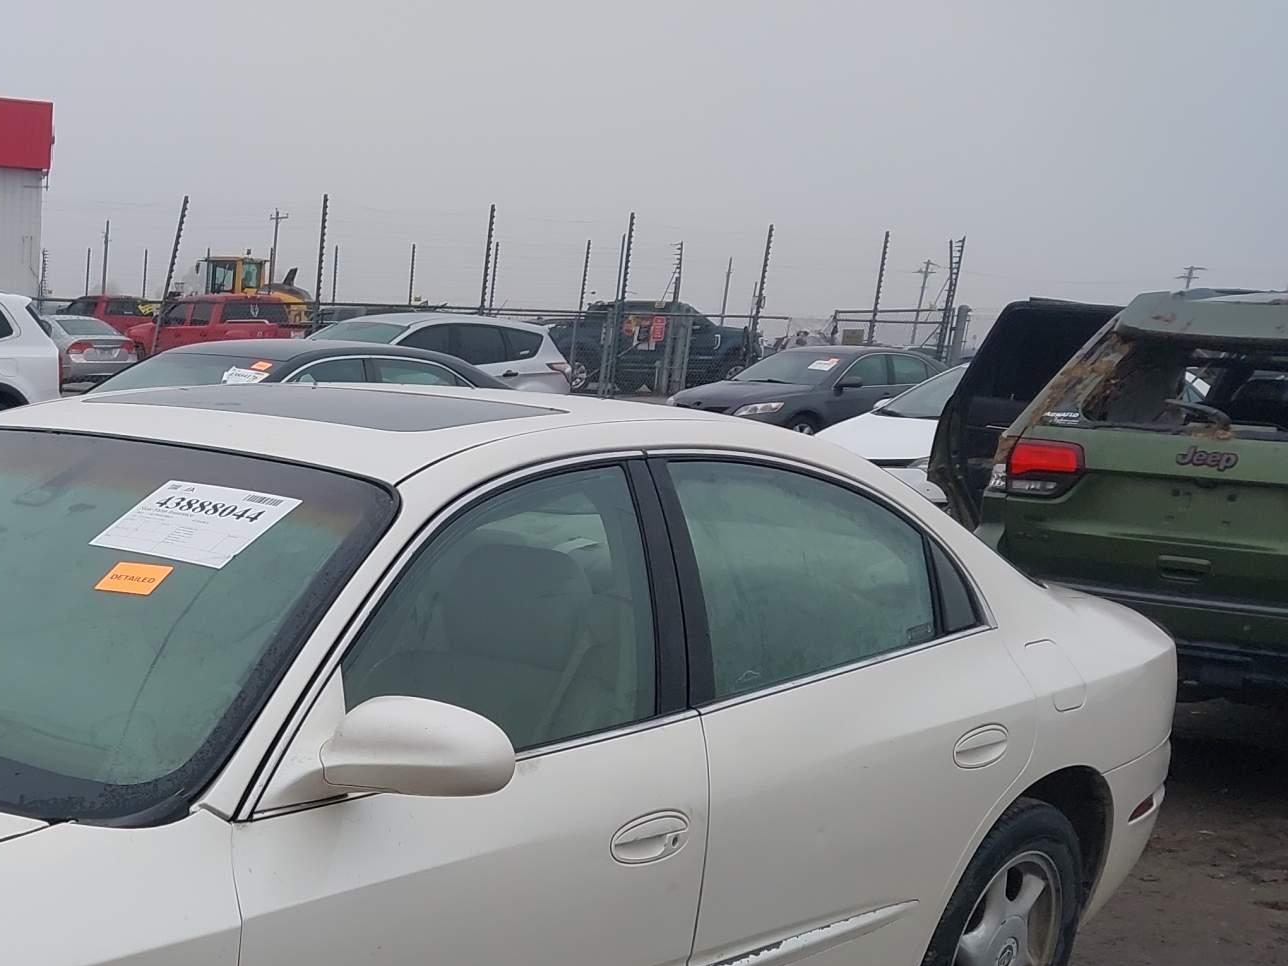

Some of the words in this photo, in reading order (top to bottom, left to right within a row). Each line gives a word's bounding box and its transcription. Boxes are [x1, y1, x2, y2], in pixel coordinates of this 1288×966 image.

[1176, 445, 1239, 472] Jeep
[155, 496, 266, 523] 43888044
[110, 574, 156, 584] DETAILED
